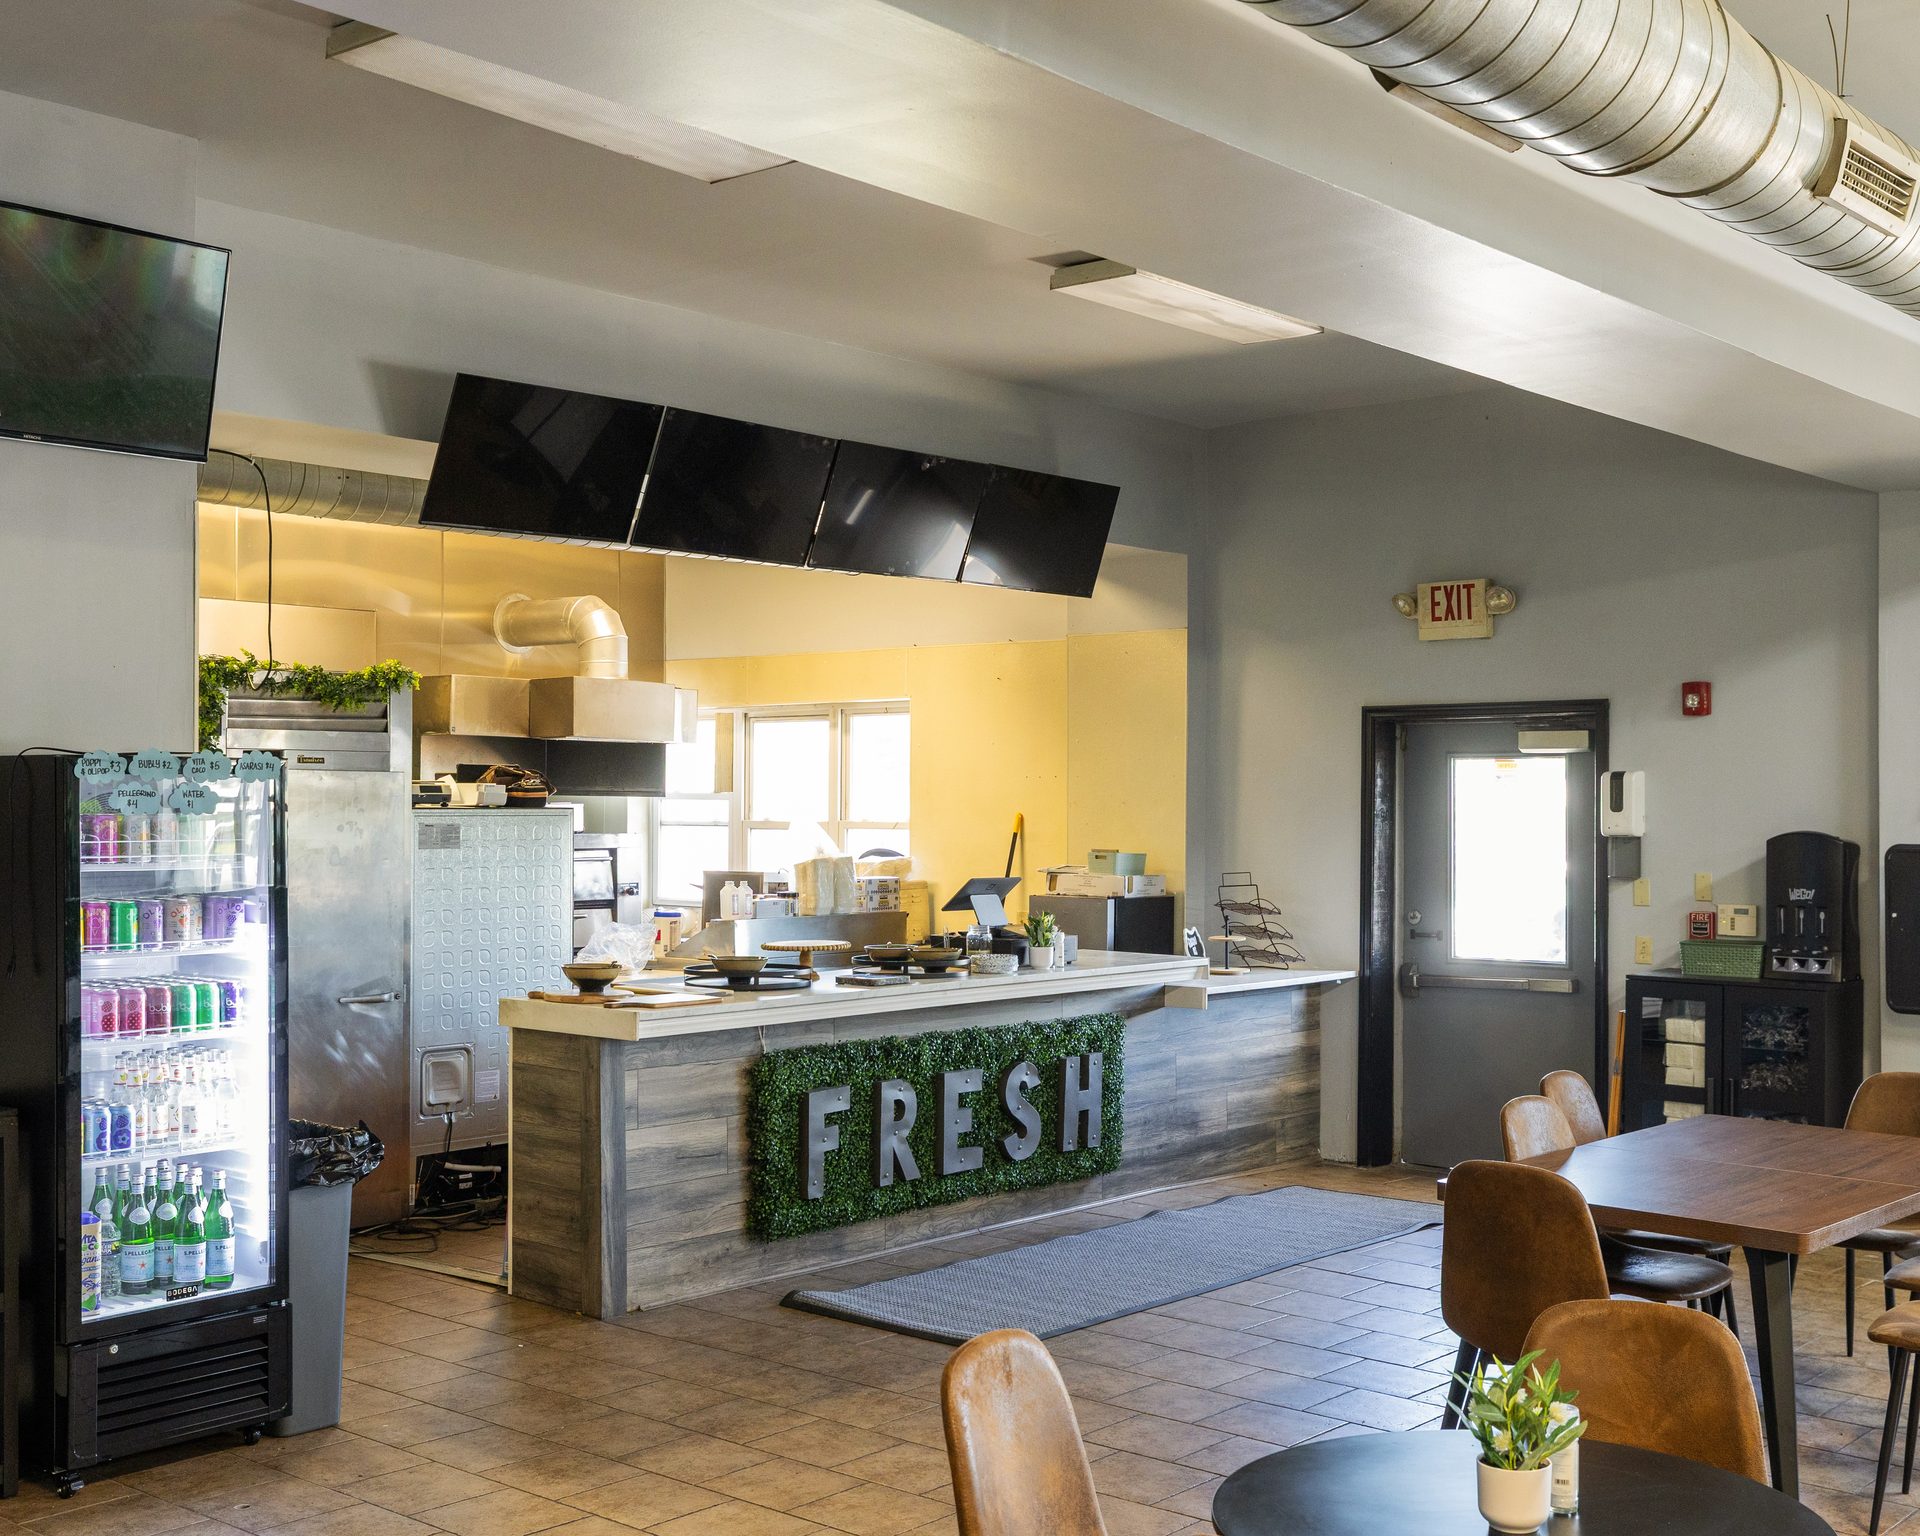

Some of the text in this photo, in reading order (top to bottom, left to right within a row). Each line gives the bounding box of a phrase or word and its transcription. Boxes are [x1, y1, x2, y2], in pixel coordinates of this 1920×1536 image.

[1430, 583, 1475, 622] EXIT
[109, 760, 121, 773] $3
[138, 759, 173, 770] BUBLY $2
[191, 758, 206, 766] VITA
[240, 761, 275, 772] ASARASI $4
[87, 767, 110, 776] OLIPOP
[117, 789, 157, 798] PELLEGRINO
[182, 789, 205, 799] WATER
[126, 799, 138, 809] $4
[187, 799, 194, 809] $1
[1690, 913, 1711, 922] FIRE
[801, 1051, 1103, 1200] FRESH
